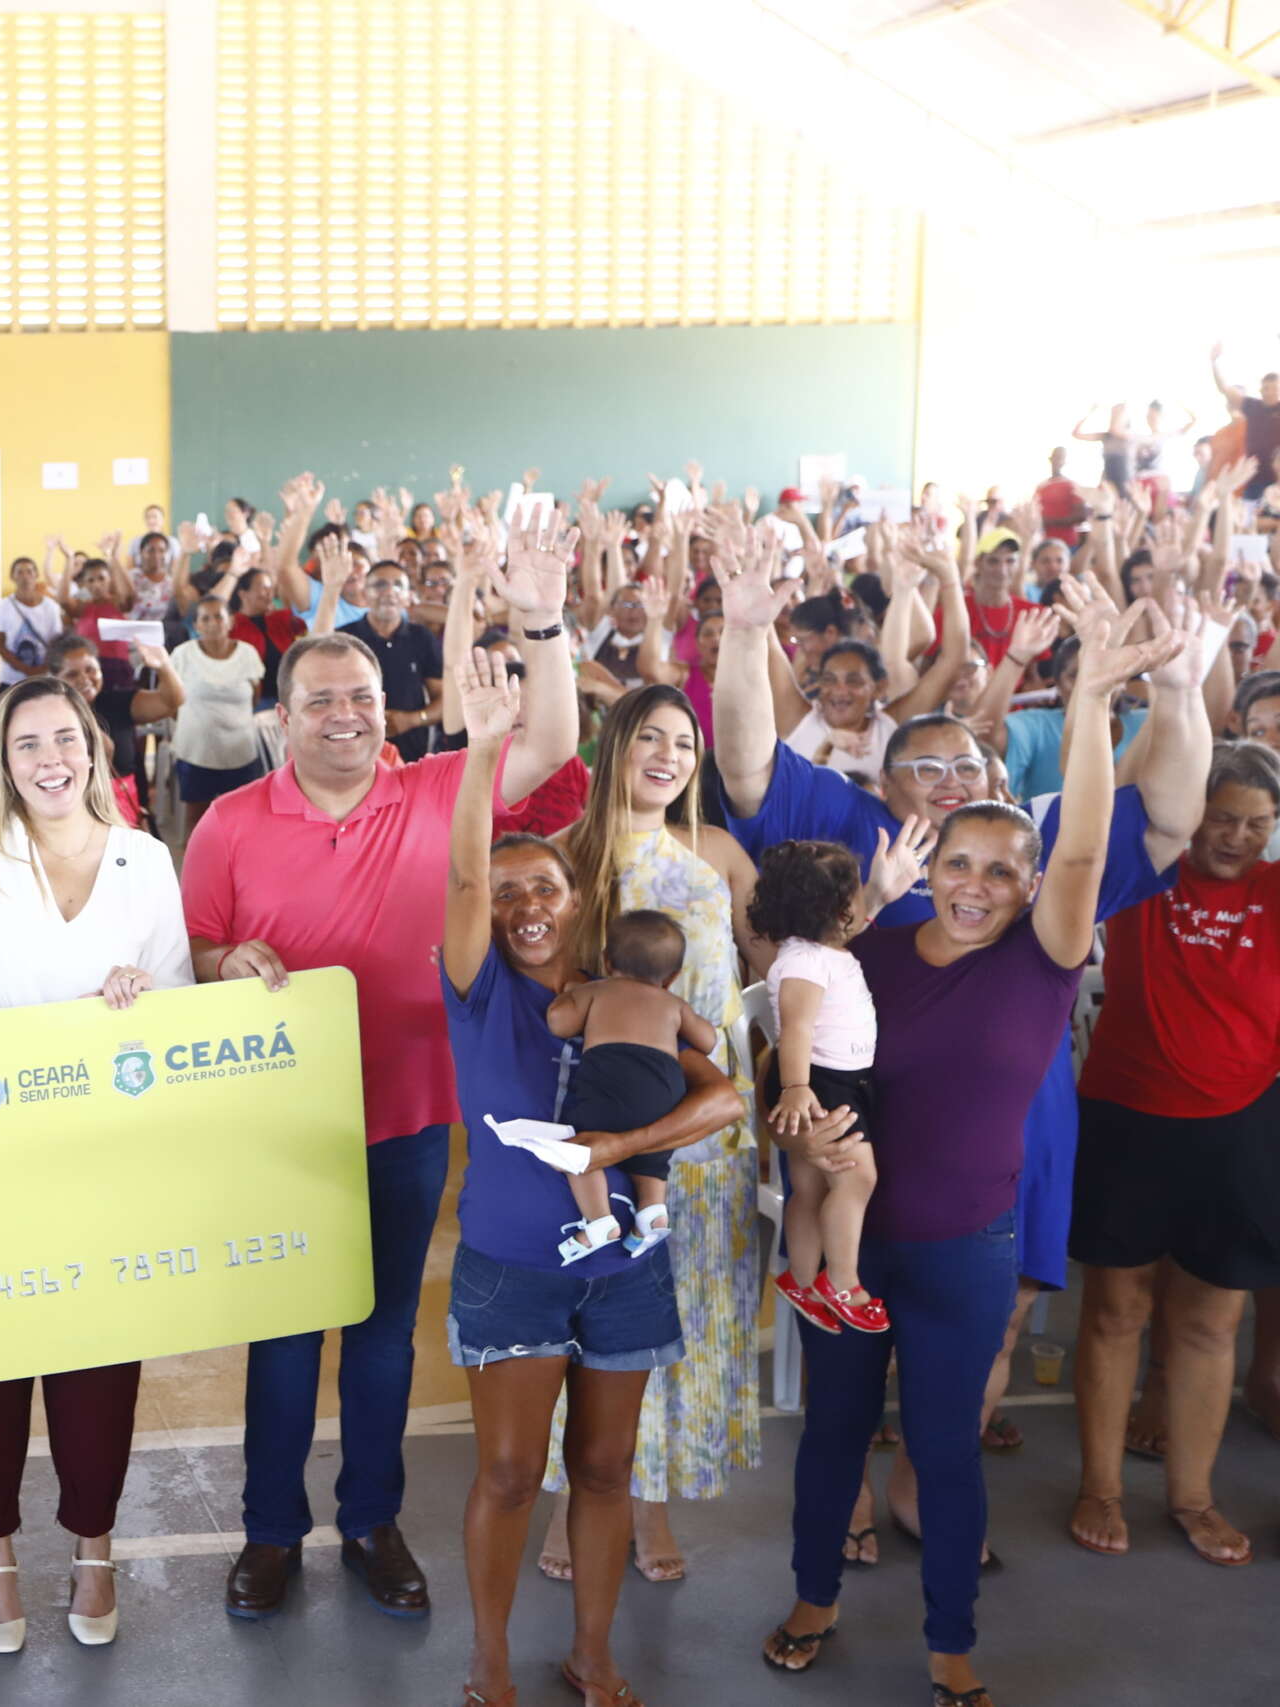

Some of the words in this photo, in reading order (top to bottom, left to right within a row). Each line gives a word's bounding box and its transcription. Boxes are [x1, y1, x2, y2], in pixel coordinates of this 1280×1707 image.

[165, 1021, 296, 1071] CEARÁ
[18, 1058, 90, 1088] CEARÁ
[166, 1068, 226, 1085] GOVERNO
[229, 1065, 248, 1076] DO
[250, 1058, 297, 1074] ESTADO
[19, 1089, 50, 1104] SEM
[53, 1083, 92, 1100] FOME
[111, 1246, 200, 1283] 7890
[223, 1231, 309, 1268] 1234
